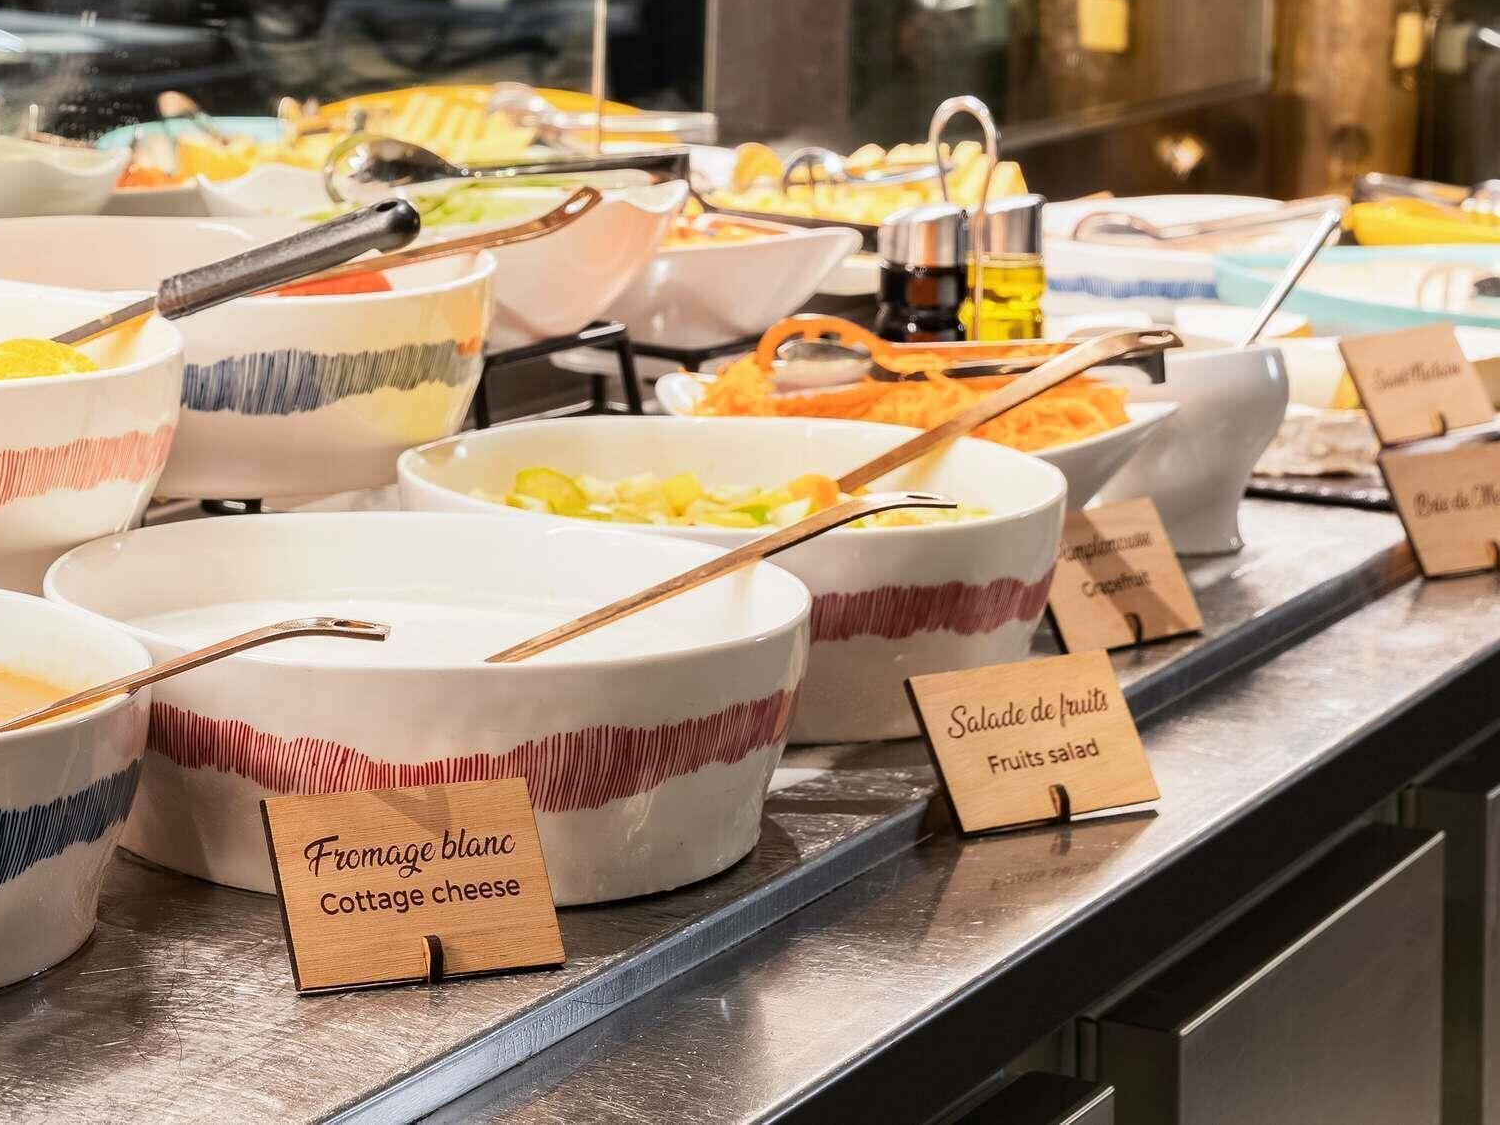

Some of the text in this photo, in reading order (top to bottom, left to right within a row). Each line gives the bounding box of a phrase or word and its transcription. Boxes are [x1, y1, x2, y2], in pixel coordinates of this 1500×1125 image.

[948, 687, 1109, 739] Salade de fruits
[987, 738, 1100, 774] Fruits salad
[304, 827, 516, 879] Fromage blanc
[320, 878, 521, 915] Cottage cheese
